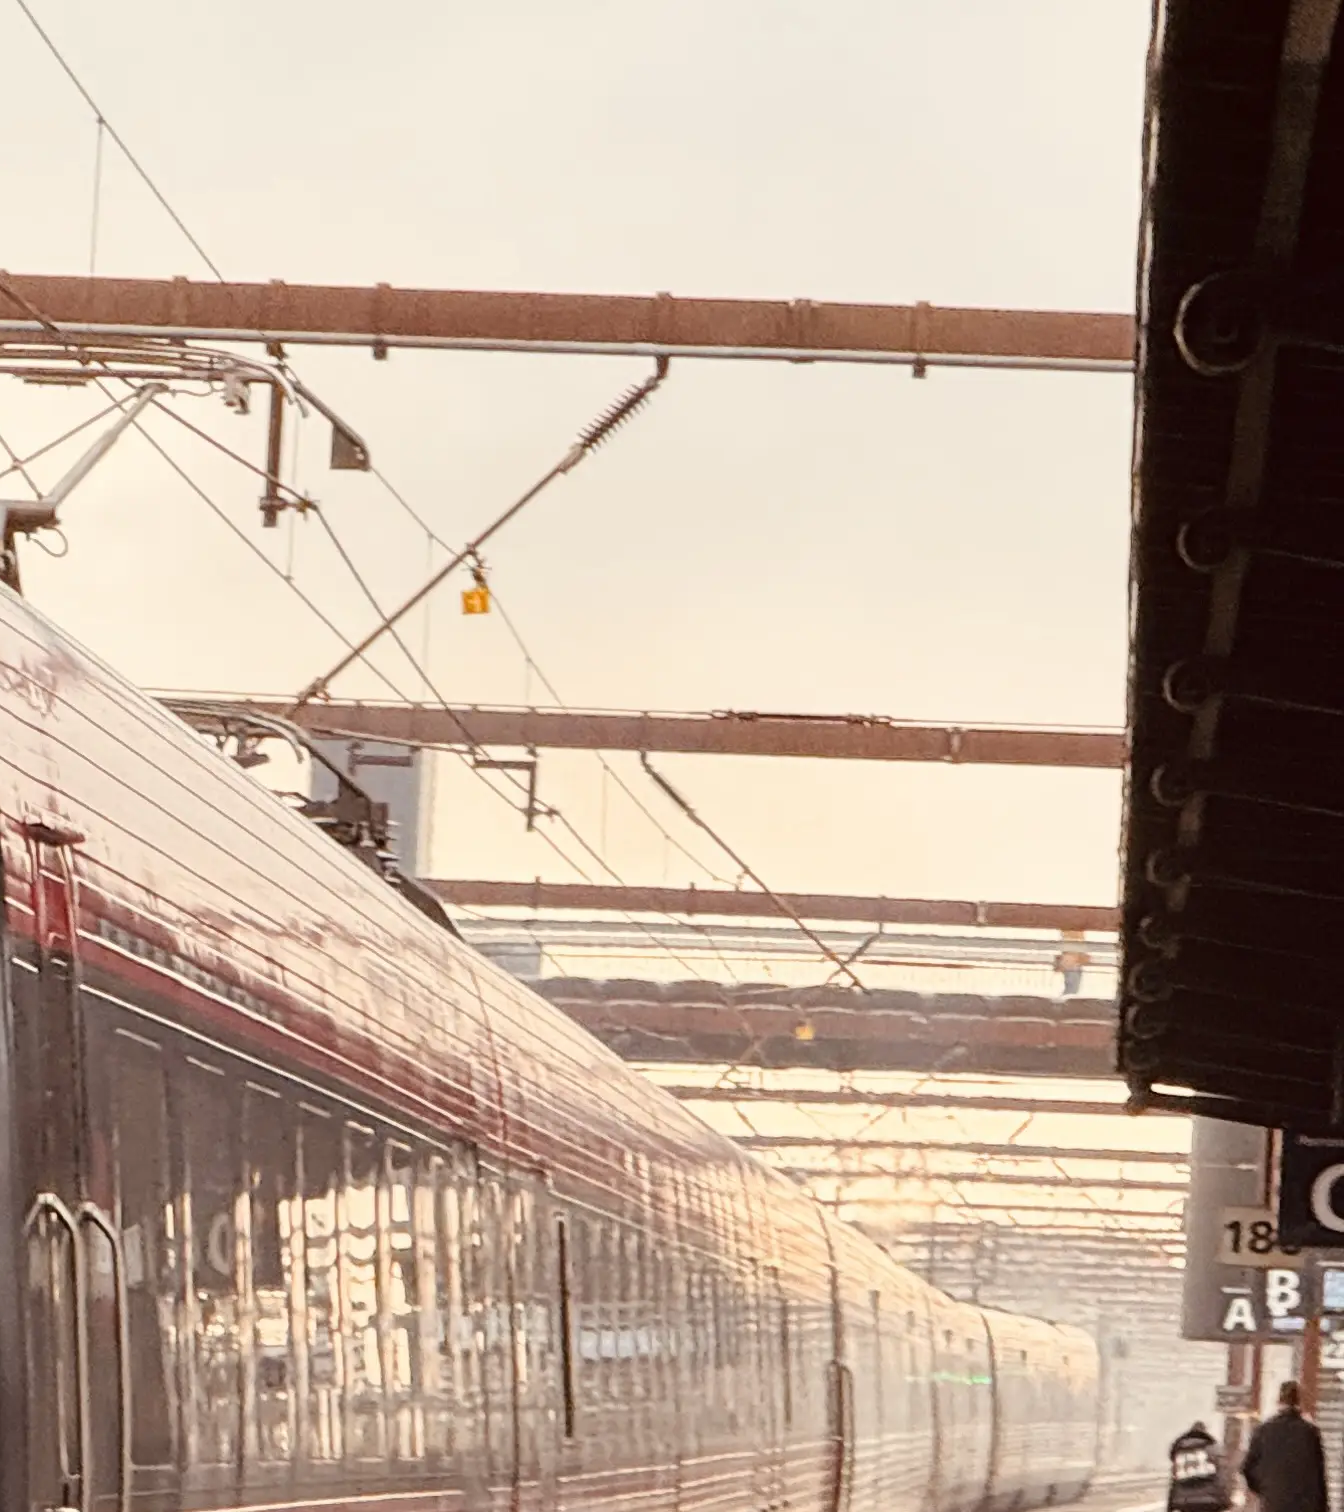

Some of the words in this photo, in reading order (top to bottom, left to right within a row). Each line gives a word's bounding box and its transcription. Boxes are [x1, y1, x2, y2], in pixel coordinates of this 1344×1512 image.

[1224, 1221, 1301, 1255] 18
[1266, 1269, 1301, 1316] B
[1223, 1298, 1257, 1331] A
